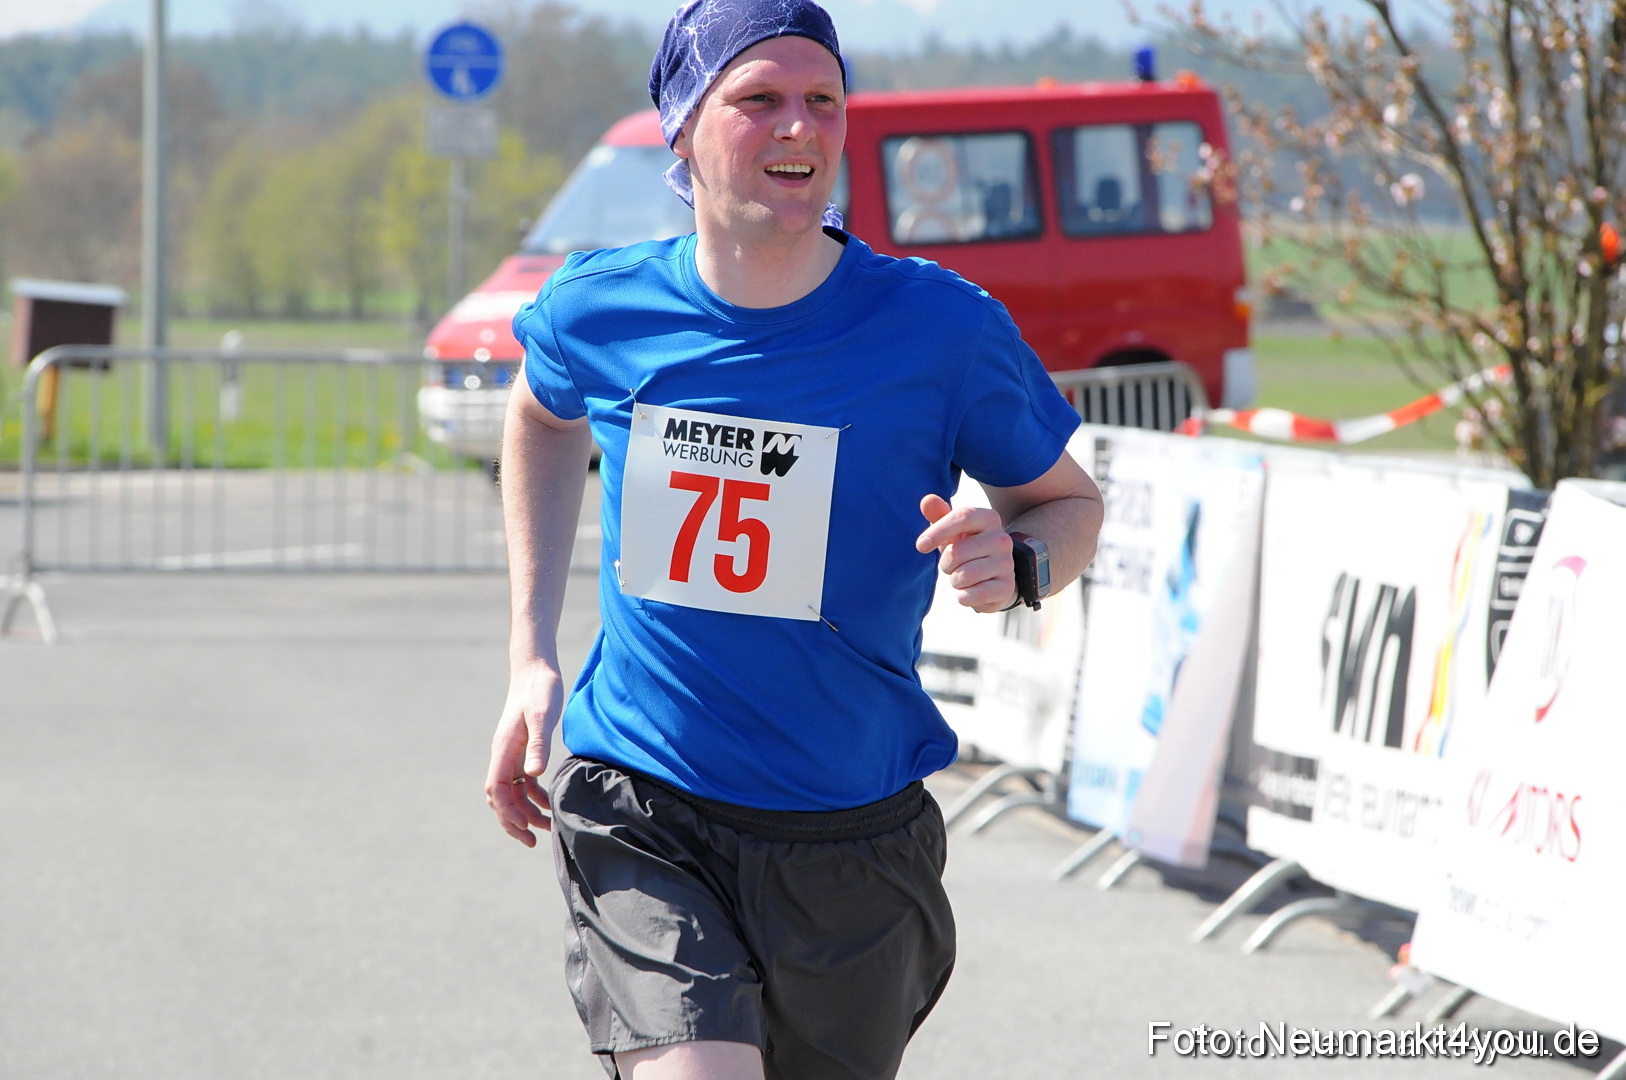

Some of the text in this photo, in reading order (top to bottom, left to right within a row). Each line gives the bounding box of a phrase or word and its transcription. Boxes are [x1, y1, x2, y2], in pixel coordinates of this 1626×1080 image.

[664, 418, 754, 450] MEYER
[663, 441, 754, 468] WERBUNG
[669, 471, 770, 593] 75
